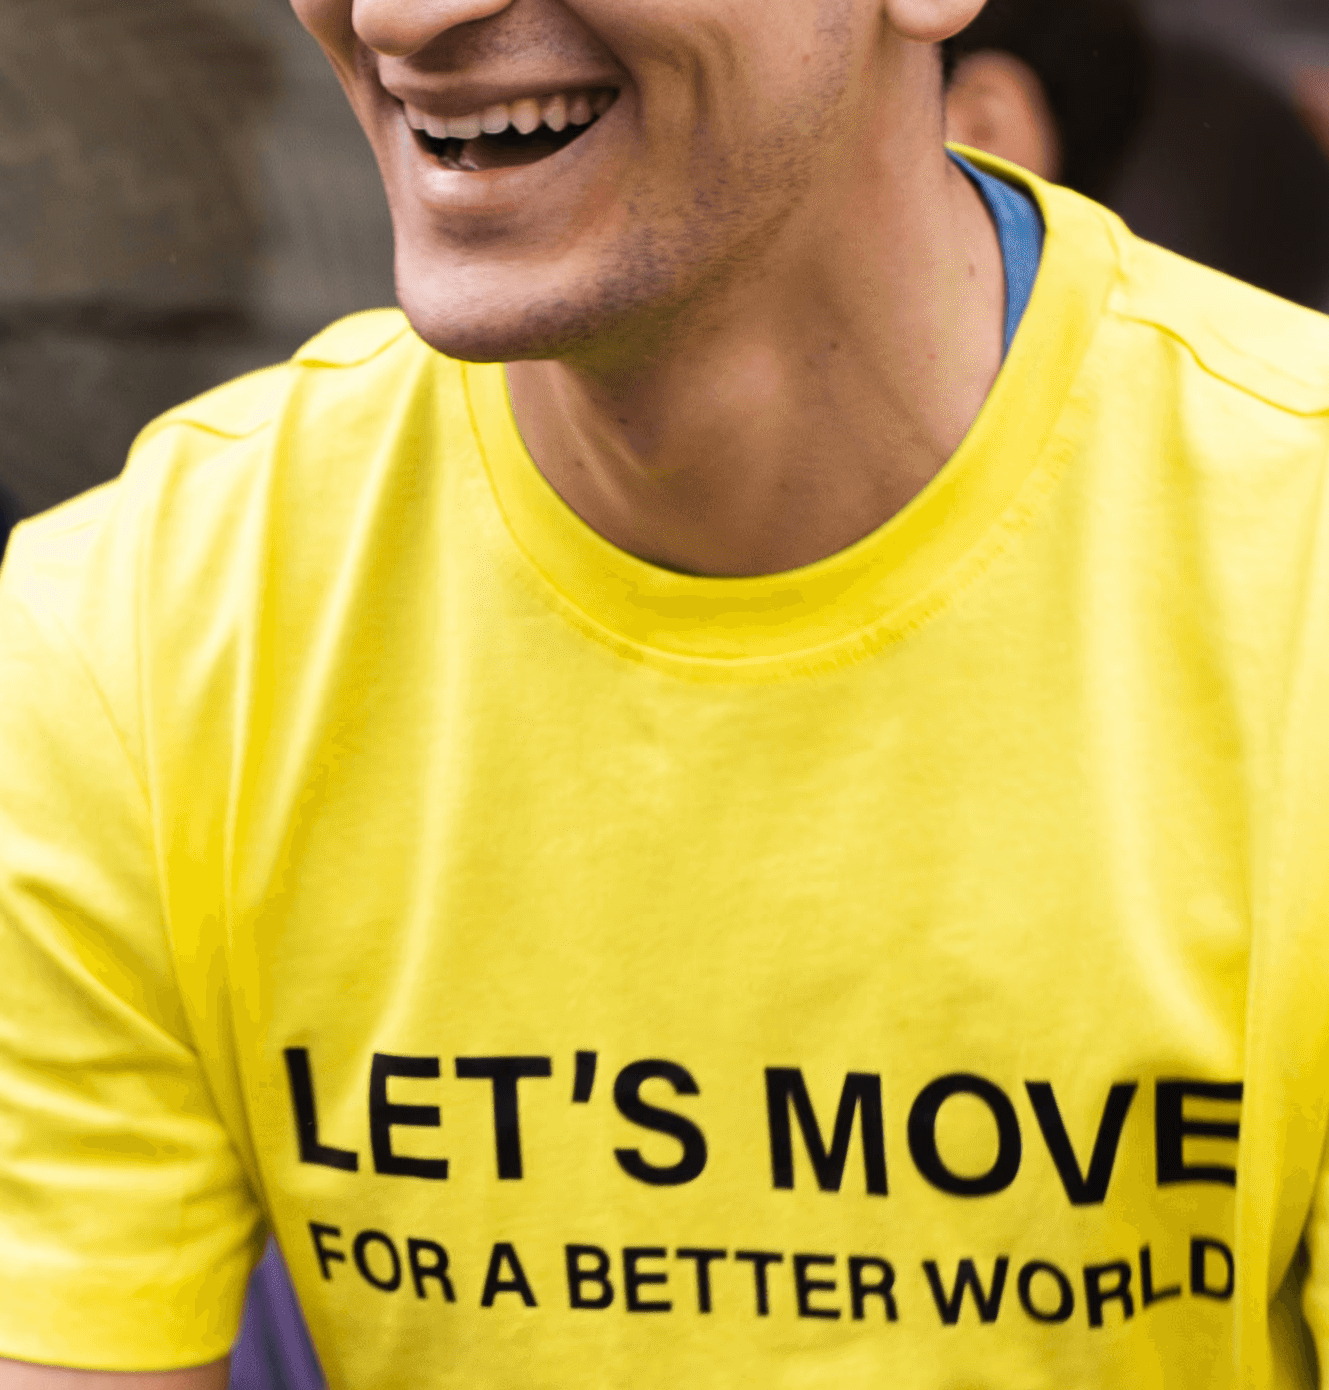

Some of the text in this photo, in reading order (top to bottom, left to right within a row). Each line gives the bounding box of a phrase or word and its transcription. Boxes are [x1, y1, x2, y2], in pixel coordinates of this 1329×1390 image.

[281, 1045, 1246, 1209] LET'S MOVE
[306, 1219, 1236, 1330] FOR A BETTER WORLD
